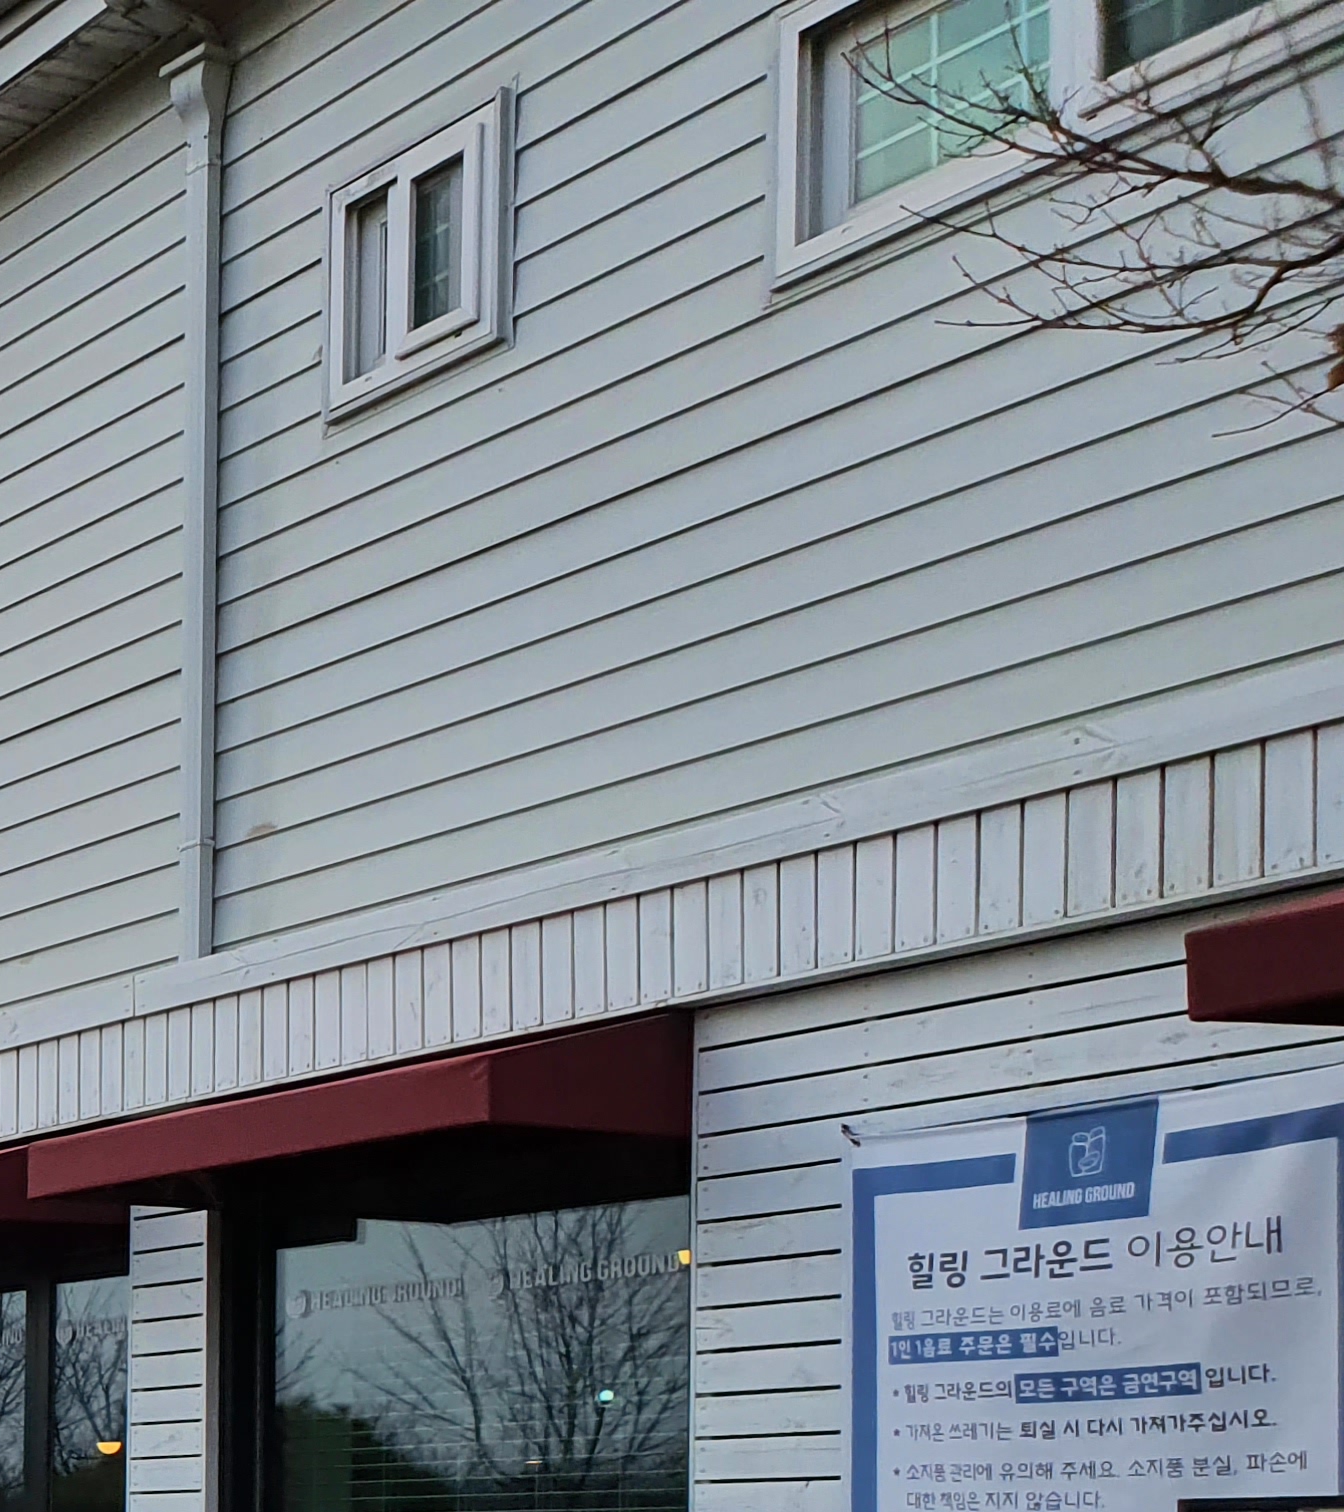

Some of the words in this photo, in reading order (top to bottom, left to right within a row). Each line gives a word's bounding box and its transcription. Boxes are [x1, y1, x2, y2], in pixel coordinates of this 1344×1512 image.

[1032, 1190, 1083, 1210] HEALING
[1085, 1182, 1135, 1205] GROUND
[597, 1252, 681, 1280] GROUND
[908, 1250, 969, 1290] 힐링
[979, 1237, 1113, 1281] 그라운드
[1127, 1215, 1283, 1269] 이용안내
[891, 1310, 916, 1332] 힐링
[920, 1304, 1004, 1327] 그라운드는
[1010, 1299, 1081, 1323] 이용료에
[1089, 1296, 1127, 1318] 음료
[1134, 1289, 1194, 1312] 가격이
[1203, 1276, 1323, 1306] 포함되므로,
[890, 1339, 912, 1360] 1인
[915, 1337, 952, 1358] 1음료
[959, 1333, 1013, 1356] 주문은
[904, 1384, 930, 1403] 힐링
[934, 1380, 1012, 1401] 그라운드의
[1019, 1378, 1055, 1399] 모든
[1060, 1374, 1117, 1397] 구역은
[1122, 1369, 1198, 1394] 금연구역
[1205, 1363, 1277, 1389] 입니다.
[906, 1422, 945, 1442] 가져온
[949, 1421, 1012, 1441] 쓰레기는
[1020, 1419, 1056, 1440] 퇴실
[1063, 1418, 1080, 1438] 시
[1087, 1415, 1123, 1437] 다시
[1130, 1408, 1279, 1435] 가져가주십시오.
[906, 1463, 946, 1483] 소지품
[949, 1463, 992, 1482] 관리에
[999, 1462, 1053, 1482] 유의해
[1060, 1460, 1121, 1481] 주세요.
[1127, 1457, 1184, 1479] 소지품
[1191, 1455, 1238, 1477] 분실,
[1247, 1450, 1308, 1474] 파손에
[906, 1492, 936, 1511] 대한
[940, 1491, 981, 1511] 책임은
[985, 1491, 1019, 1510] 지지
[1025, 1490, 1106, 1512] 않습니다.
